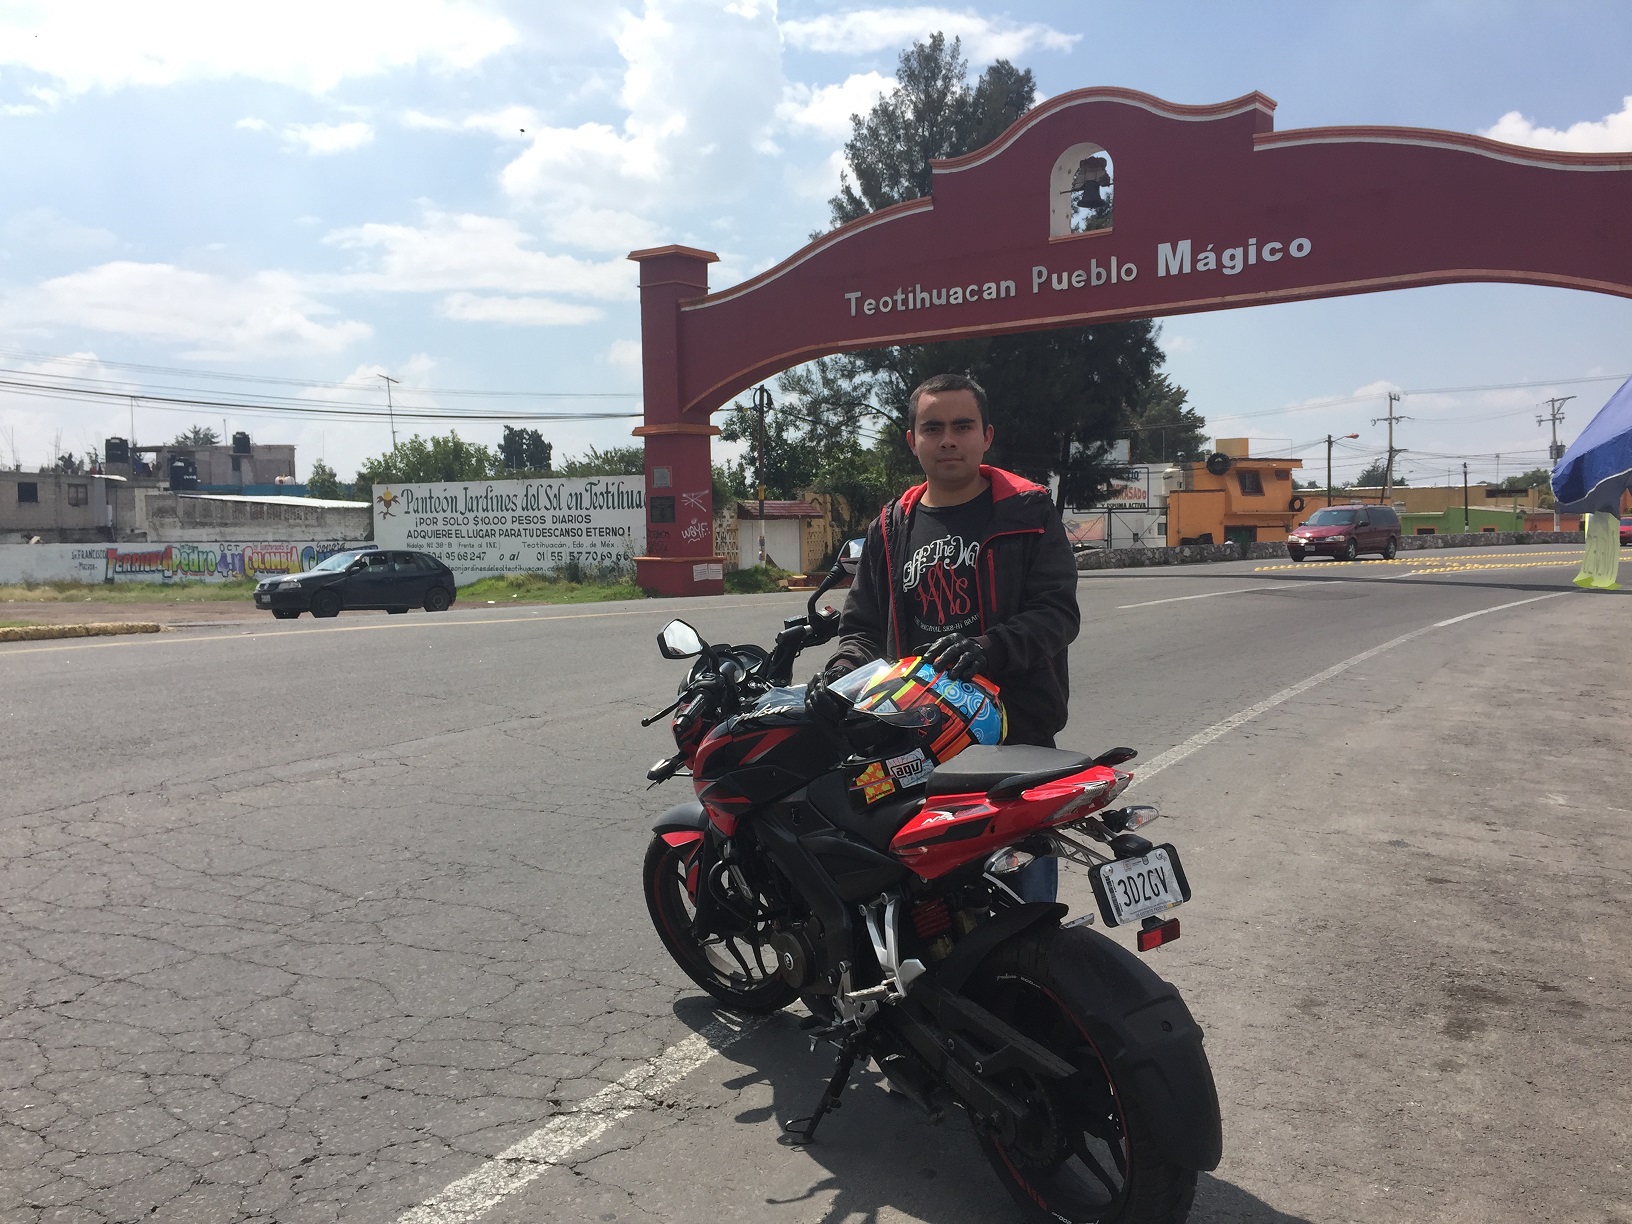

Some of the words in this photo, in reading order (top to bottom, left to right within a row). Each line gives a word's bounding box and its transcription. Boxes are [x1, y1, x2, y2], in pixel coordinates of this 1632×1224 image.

[844, 279, 1016, 317] Teotihuacan
[1032, 256, 1138, 294] Pueblo
[1157, 237, 1312, 277] Mágico
[401, 488, 459, 514] Panteón
[460, 485, 518, 515] Jardines
[521, 484, 543, 512] del
[544, 483, 565, 511] Sol
[566, 491, 584, 511] en
[406, 529, 453, 540] ADQUIERE
[455, 528, 466, 539] EL
[467, 528, 497, 539] LUGAR
[522, 528, 534, 538] TU
[535, 527, 583, 538] DESCANSO
[442, 515, 470, 526] SOLO
[473, 514, 507, 527] $10.00
[511, 515, 547, 525] PESOS
[551, 514, 592, 525] DIARIOS
[172, 546, 216, 574] Pedro
[219, 543, 241, 552] OCT
[406, 542, 424, 550] Hidalgo
[243, 545, 301, 577] COLOMBIA
[1117, 866, 1168, 907] 3D2GV
